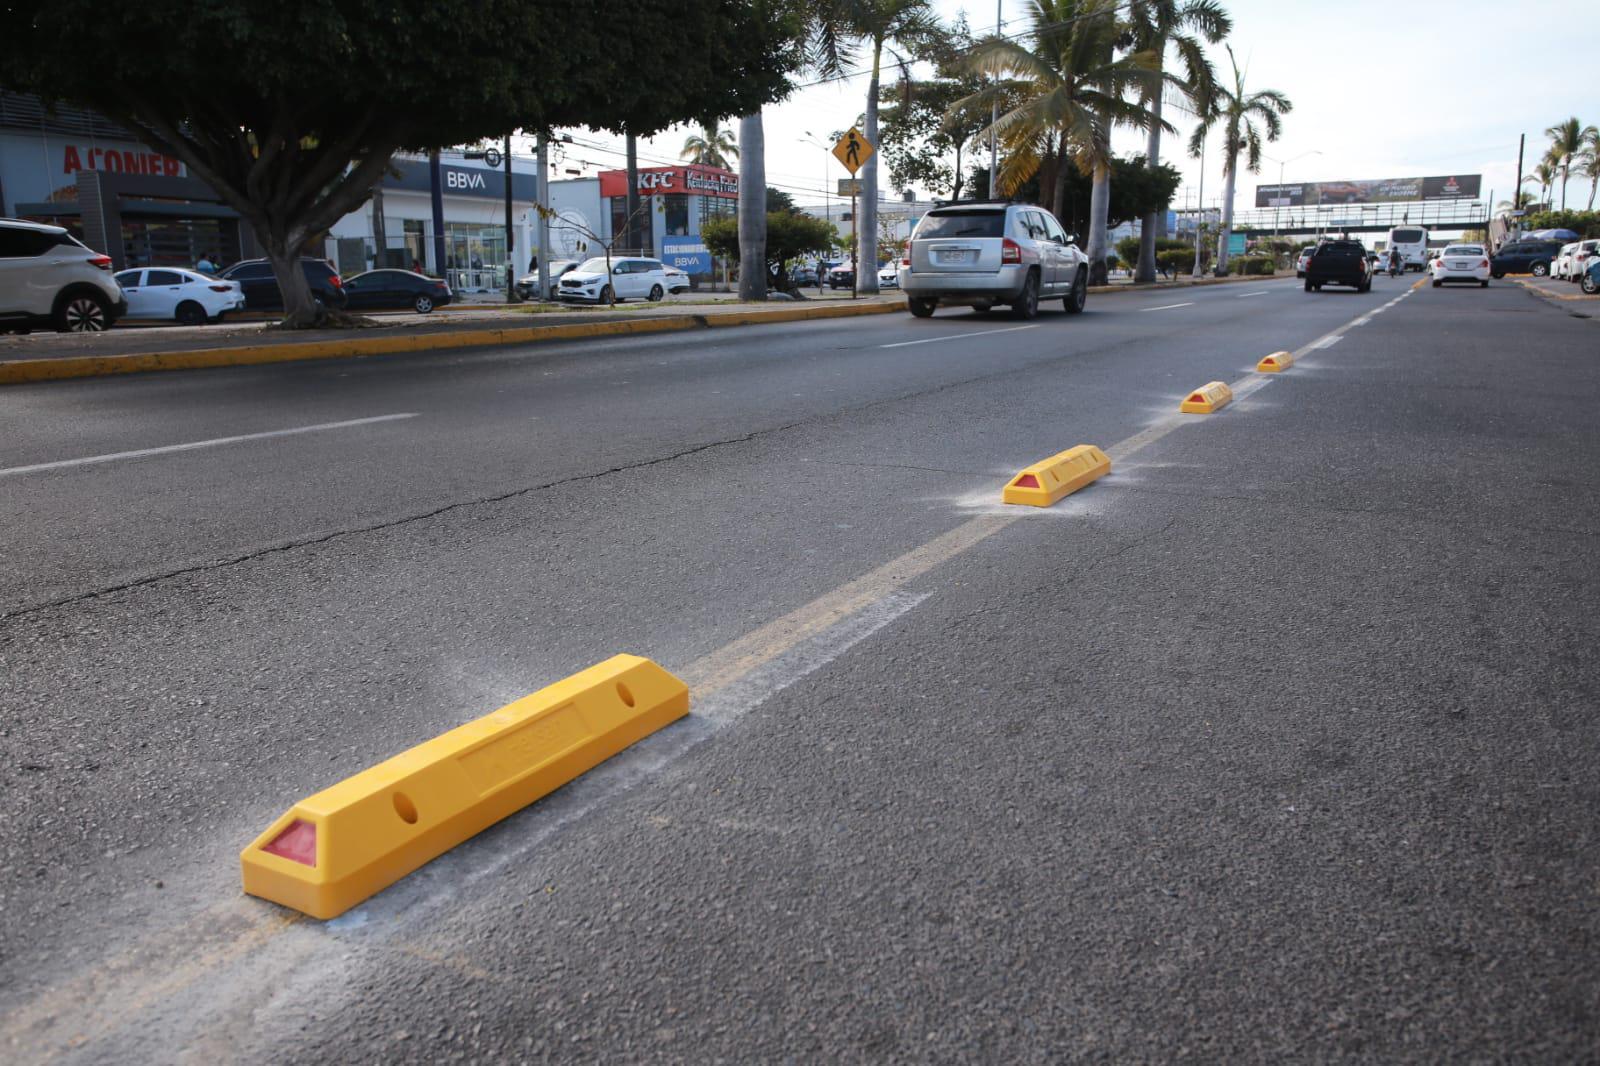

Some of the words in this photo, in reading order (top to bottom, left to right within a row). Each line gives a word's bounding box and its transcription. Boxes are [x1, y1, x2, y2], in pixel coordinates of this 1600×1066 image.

[447, 171, 486, 189] BBVA
[637, 171, 675, 189] KFC
[674, 256, 700, 267] BBVA
